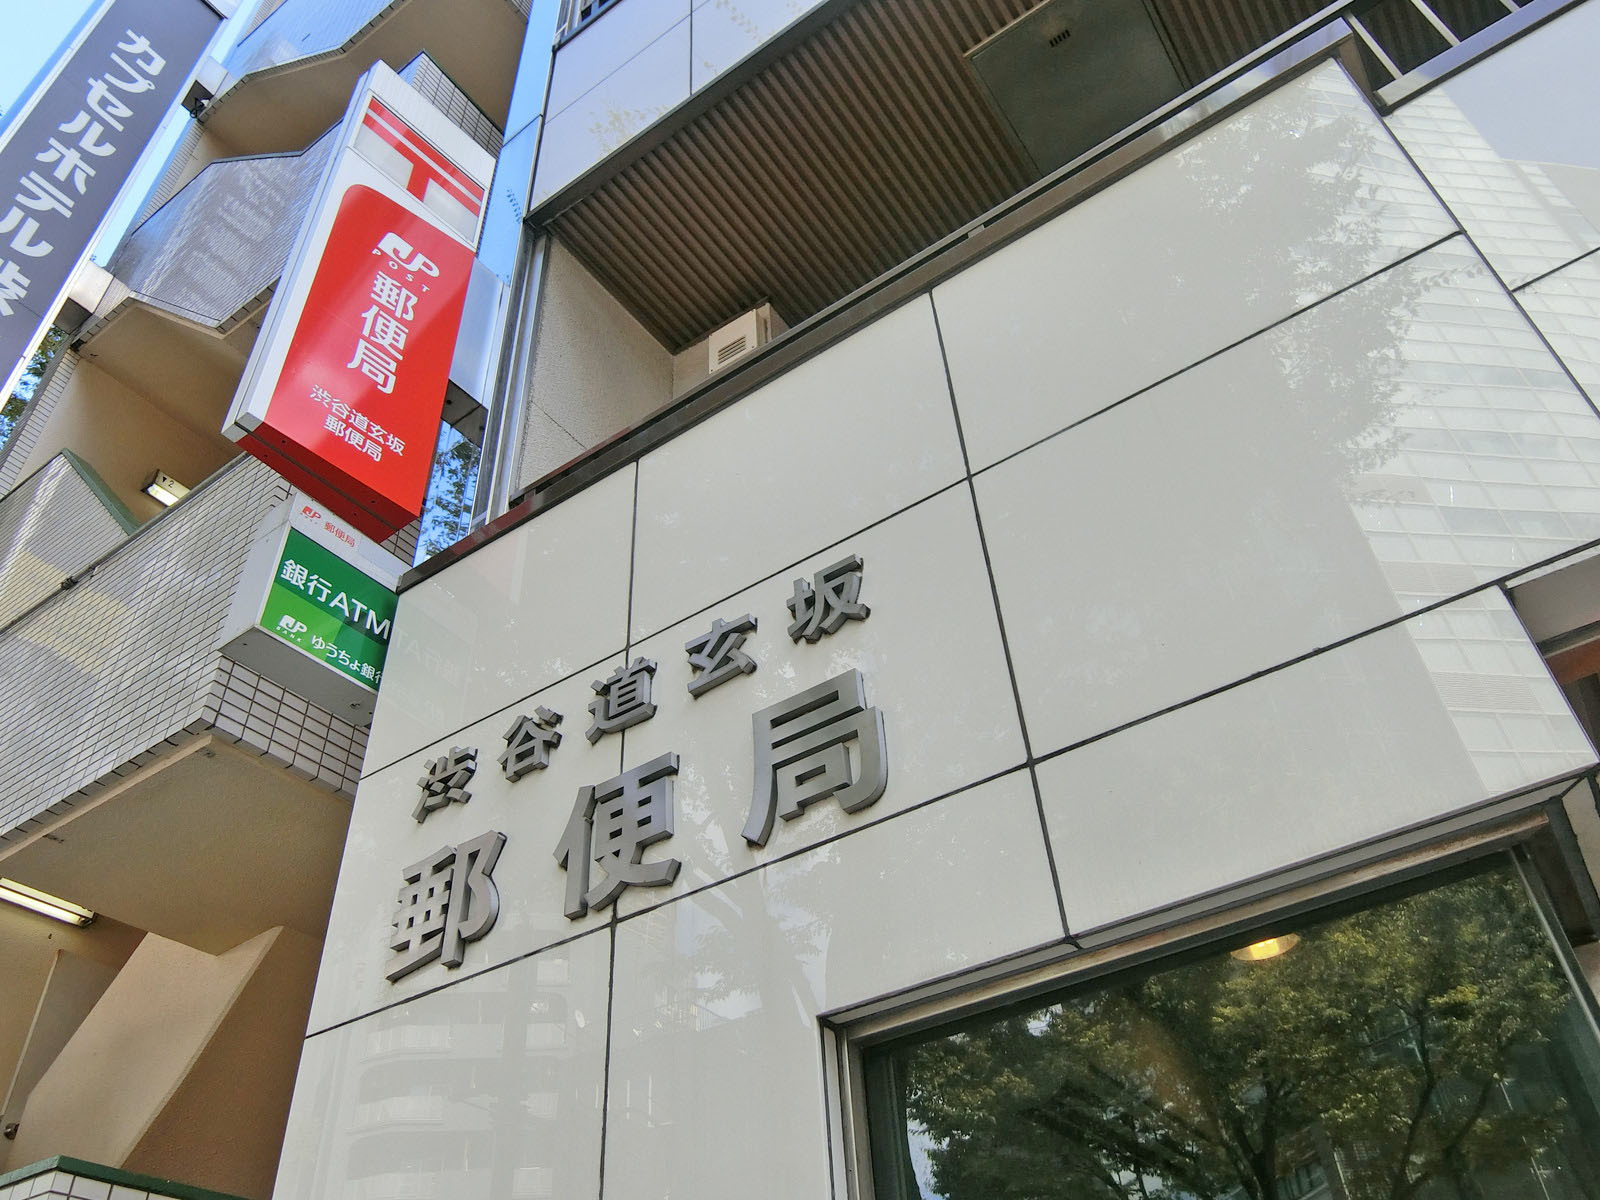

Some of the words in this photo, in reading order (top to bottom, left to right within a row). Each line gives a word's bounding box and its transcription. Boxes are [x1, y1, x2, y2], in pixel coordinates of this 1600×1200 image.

[371, 248, 430, 293] POST
[346, 270, 418, 395] 郵便局
[309, 384, 406, 457] 渋谷道玄坂
[323, 414, 383, 462] 郵便局
[324, 521, 356, 548] 郵便局
[280, 559, 391, 640] 銀行ATM
[411, 554, 871, 822] 渋谷道玄坂
[385, 668, 888, 982] 郵便局
